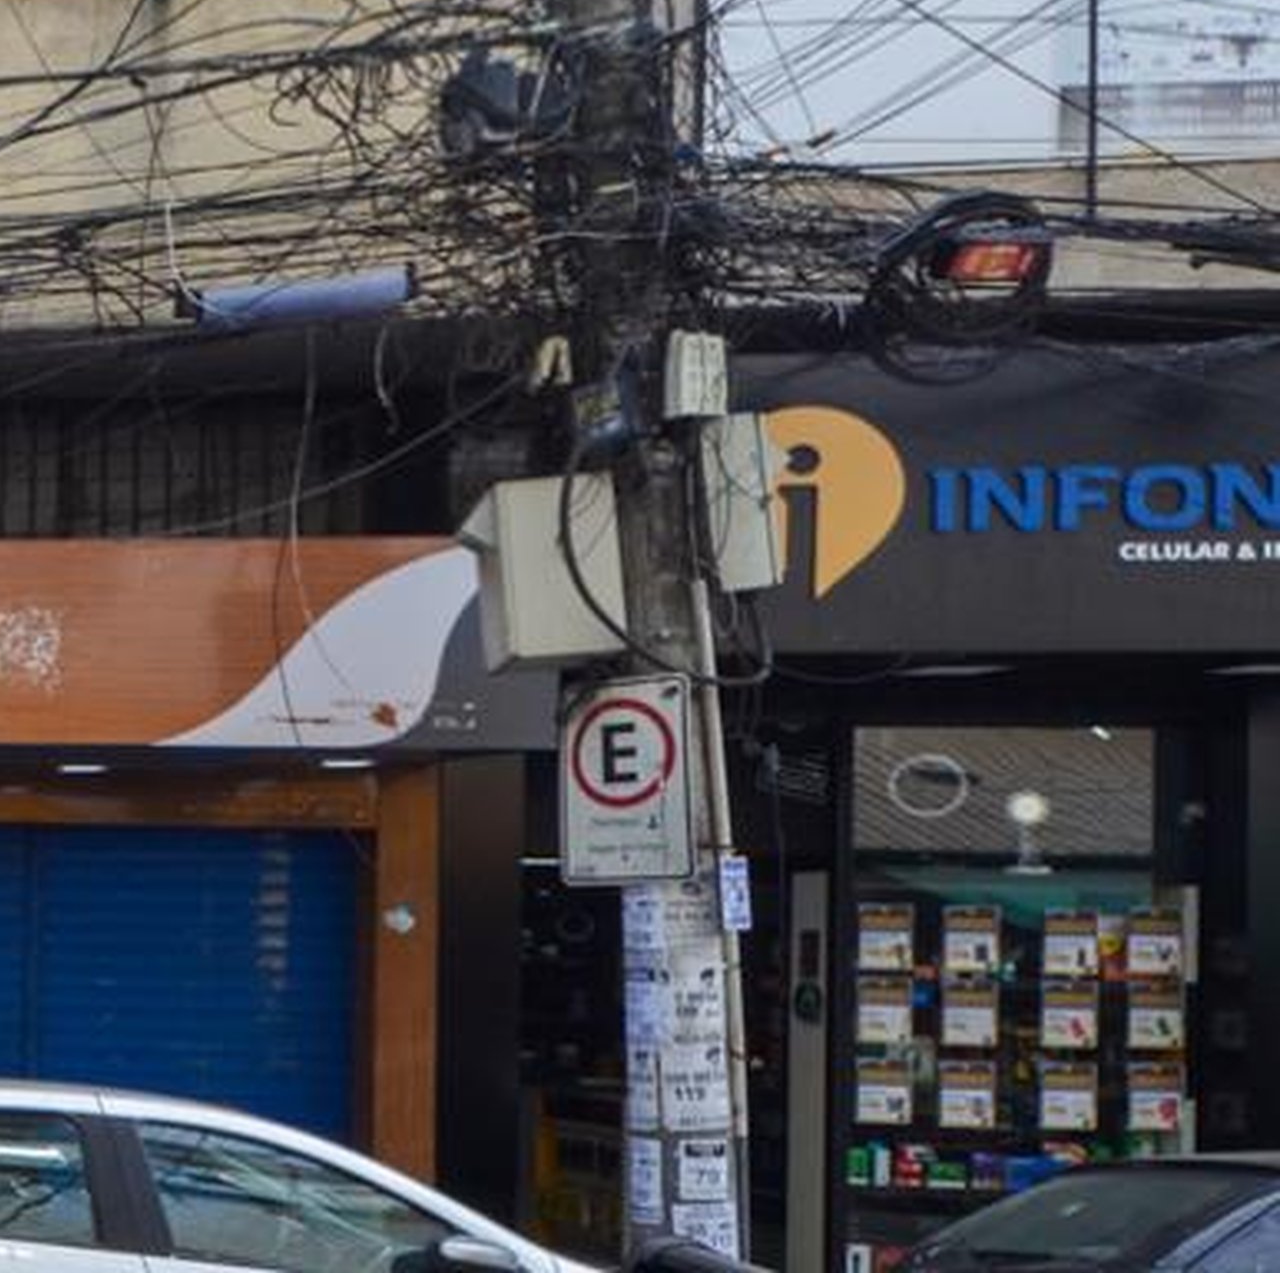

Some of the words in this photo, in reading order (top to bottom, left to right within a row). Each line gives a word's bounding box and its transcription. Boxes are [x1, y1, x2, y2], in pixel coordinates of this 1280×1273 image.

[1119, 541, 1231, 562] CELULAR
[1237, 542, 1256, 560] &
[600, 722, 639, 784] E
